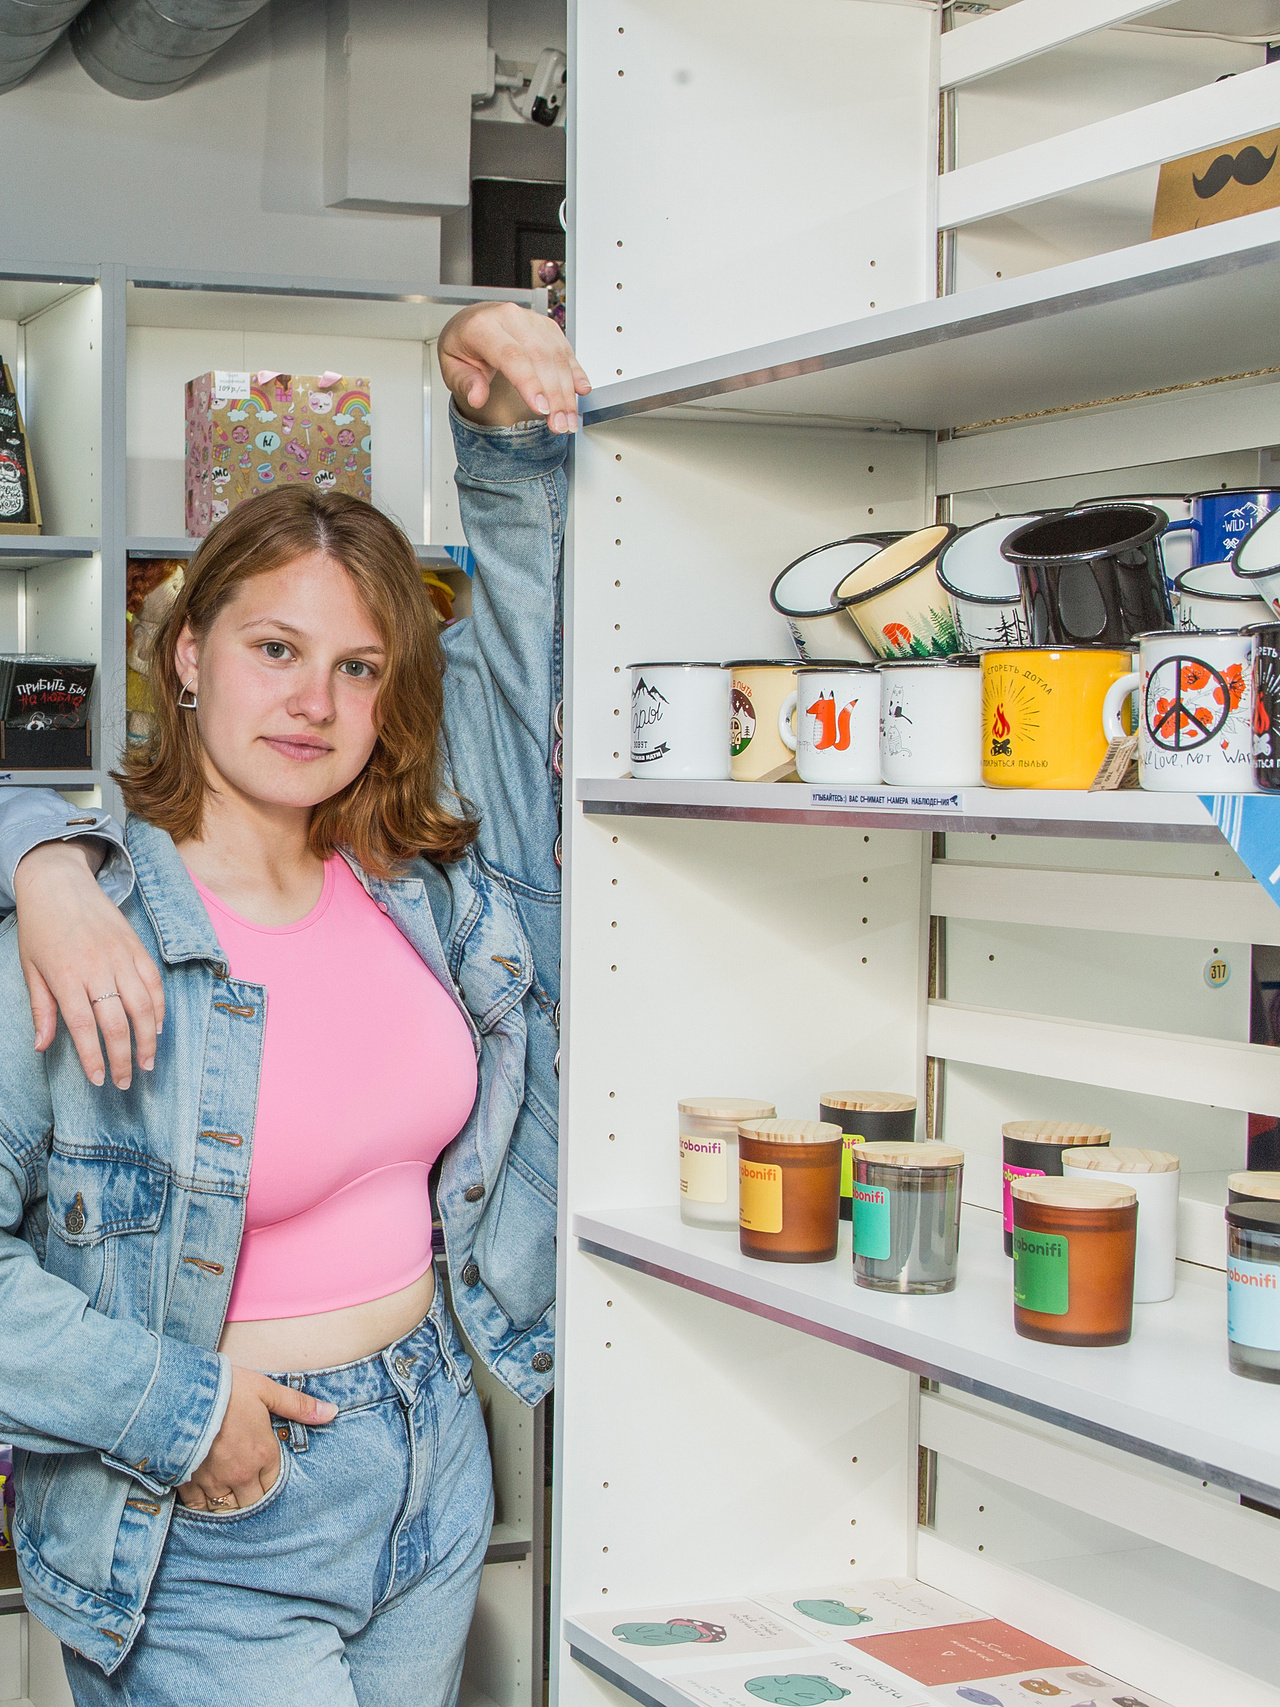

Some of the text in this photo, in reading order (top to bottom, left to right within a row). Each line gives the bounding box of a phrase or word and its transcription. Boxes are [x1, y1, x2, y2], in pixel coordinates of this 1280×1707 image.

[263, 436, 272, 447] hi
[314, 471, 334, 484] OMG
[16, 678, 66, 696] ПРИБИТЬ
[987, 664, 1053, 695] СГОРЕТЬ ДОТЛА
[736, 681, 753, 698] ПУТЬ
[40, 692, 83, 707] ЛЮБЛЮ
[1019, 760, 1049, 768] ПЫЛЬЮ
[860, 796, 885, 804] СНИМАЕТ
[887, 797, 909, 805] КАМЕРА
[911, 797, 950, 807] НАБЛЮДЕНИЯ
[1211, 964, 1227, 979] 317
